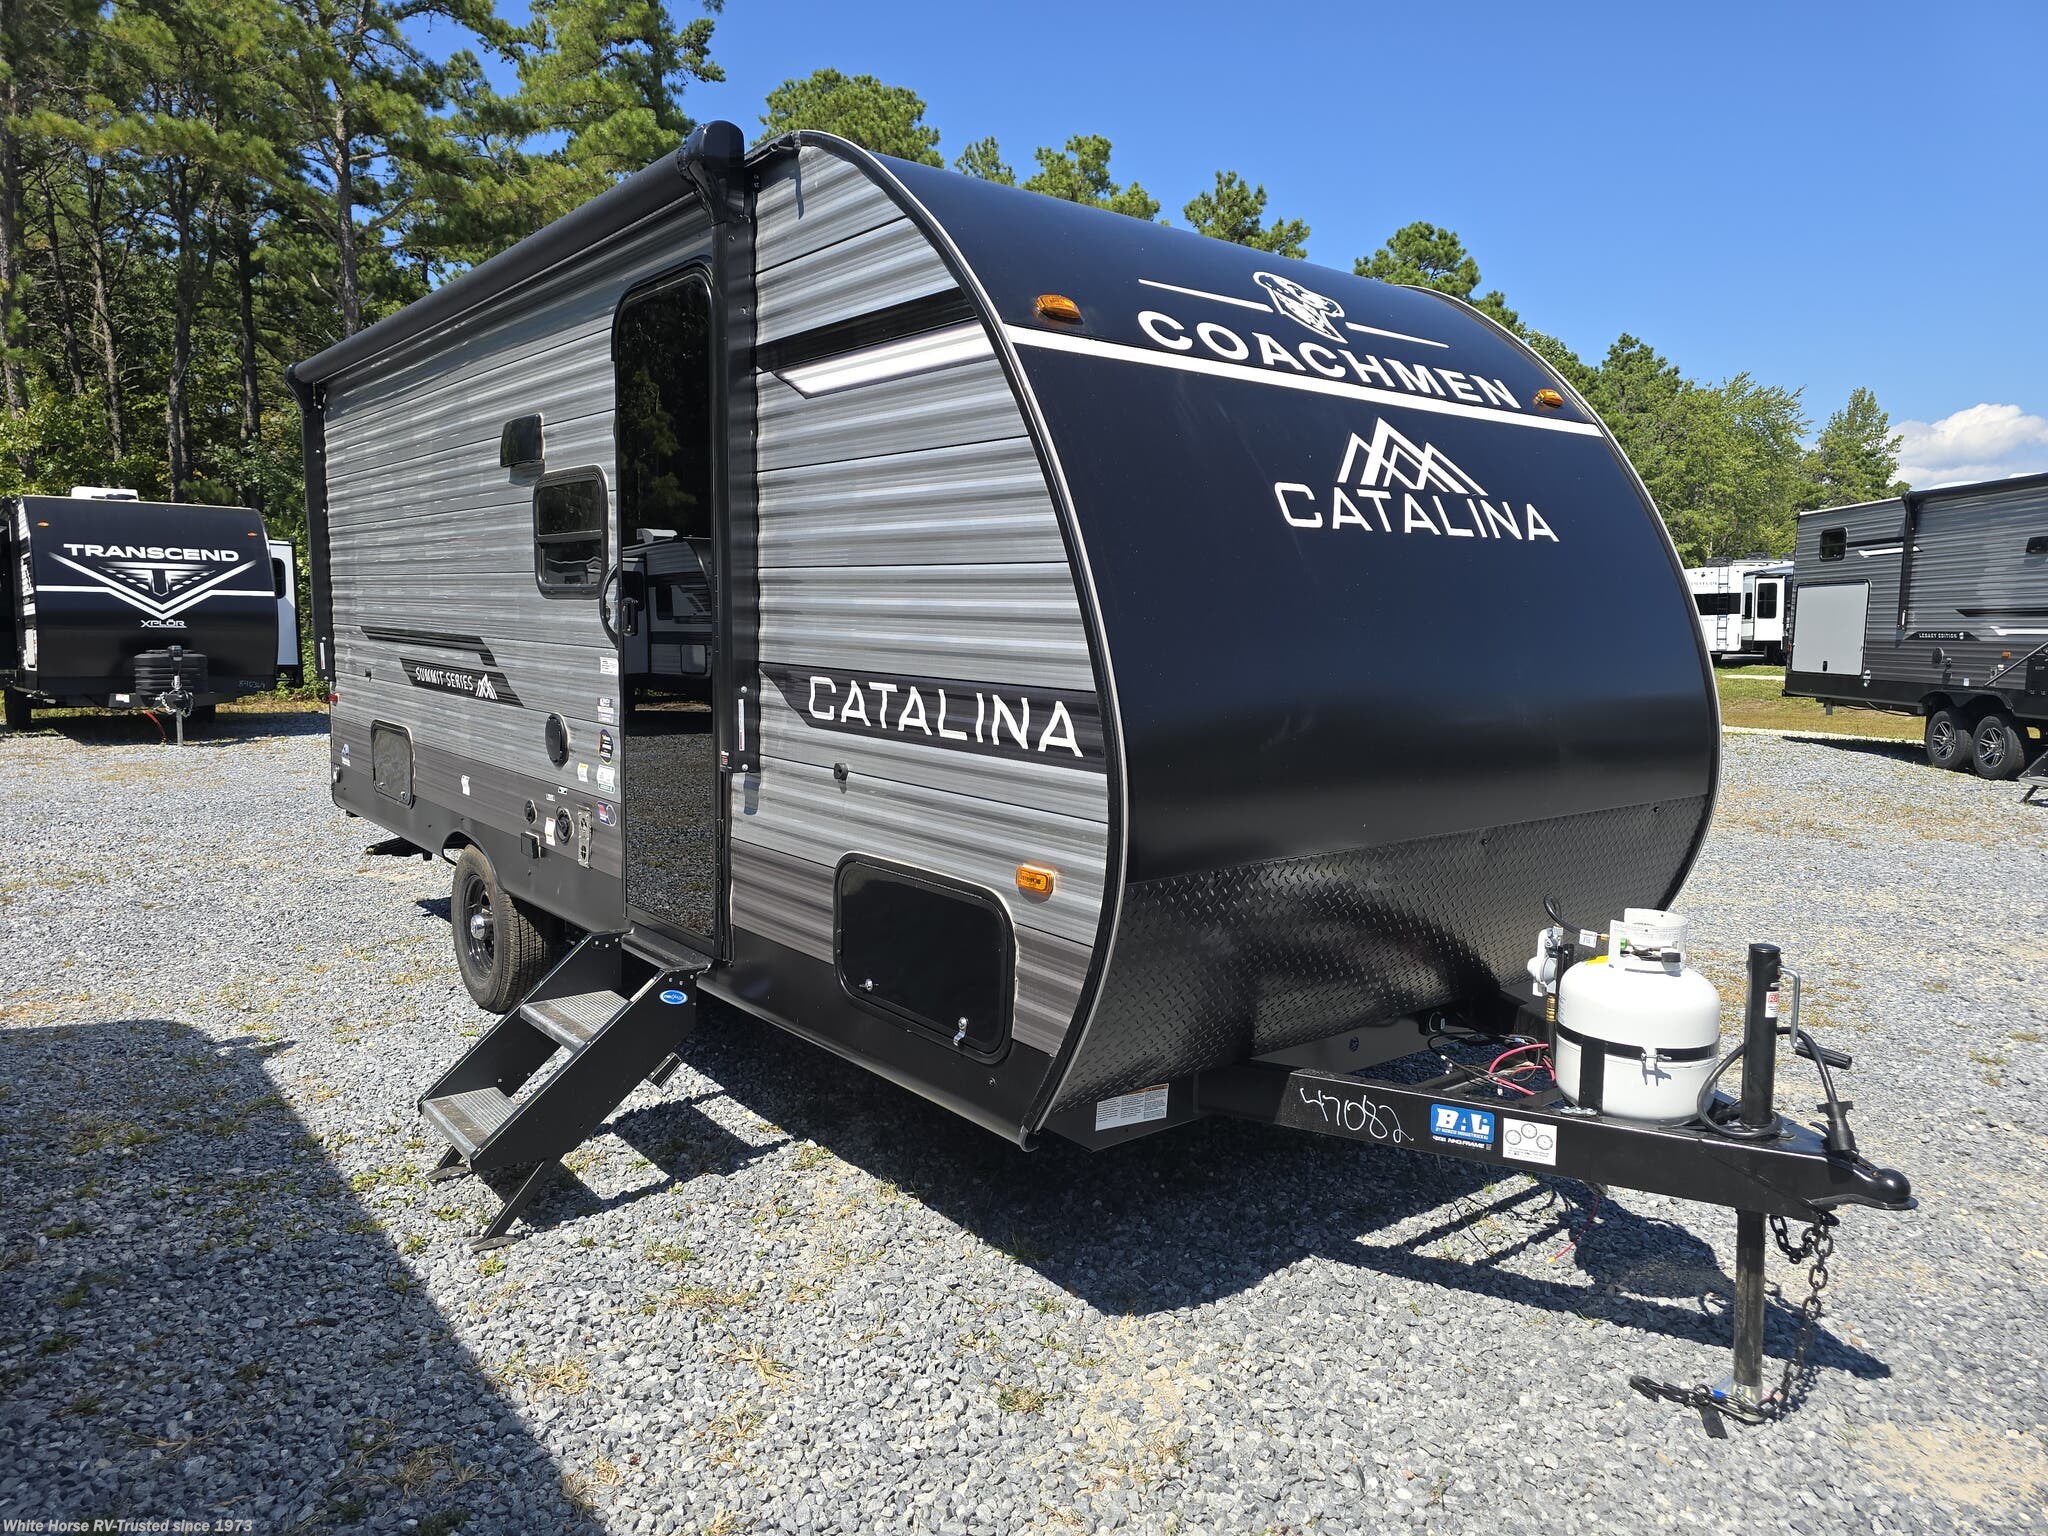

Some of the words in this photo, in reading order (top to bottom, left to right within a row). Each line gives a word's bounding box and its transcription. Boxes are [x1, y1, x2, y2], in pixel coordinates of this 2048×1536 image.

[1137, 310, 1522, 409] COACHMEN
[1274, 482, 1560, 543] CATALINA
[63, 543, 239, 562] TRANSCEND
[415, 667, 444, 685] SUMMIT
[446, 672, 473, 690] SERIES
[808, 675, 1084, 758] CATALINA
[1300, 1087, 1415, 1144] 47082
[1436, 1107, 1490, 1135] BAL
